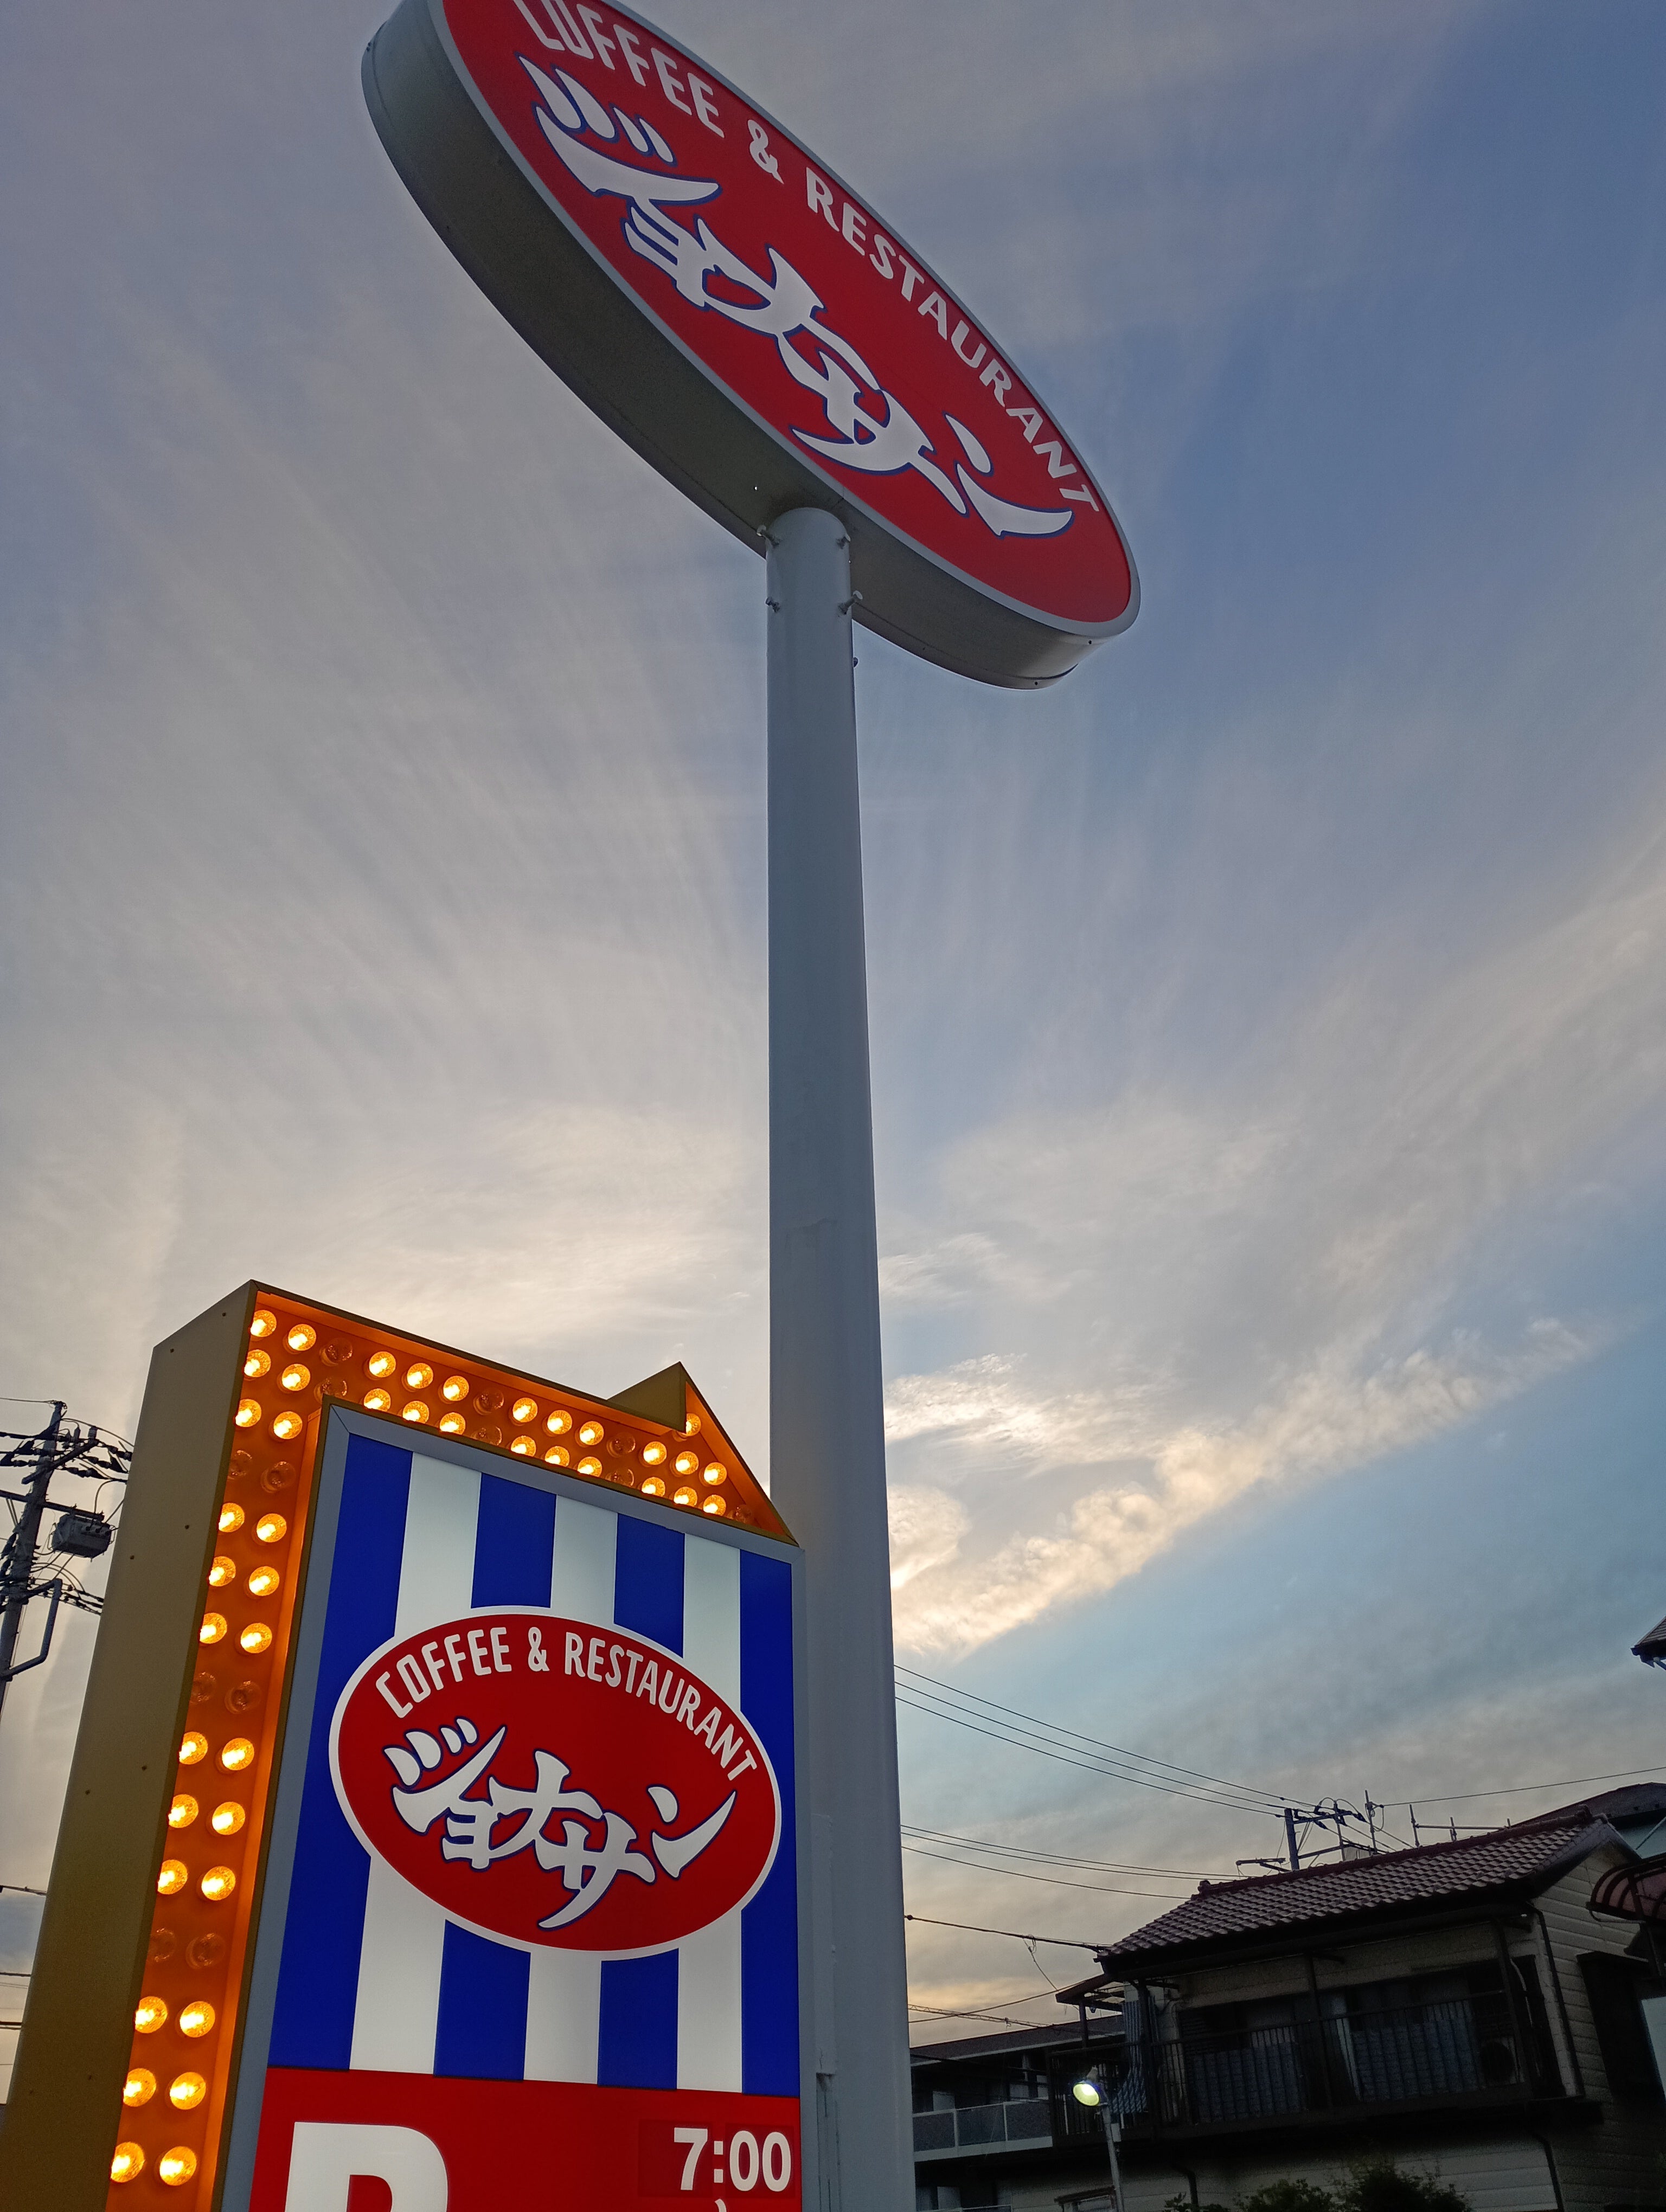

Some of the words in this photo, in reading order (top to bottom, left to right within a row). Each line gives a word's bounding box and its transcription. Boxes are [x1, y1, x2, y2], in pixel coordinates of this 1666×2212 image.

[747, 119, 784, 183] &
[806, 166, 1100, 513] RESTAURANT
[375, 1626, 512, 1718] COFFEE
[528, 1626, 549, 1671] &
[565, 1631, 758, 1781] RESTAURANT
[674, 2127, 791, 2192] 7:00
